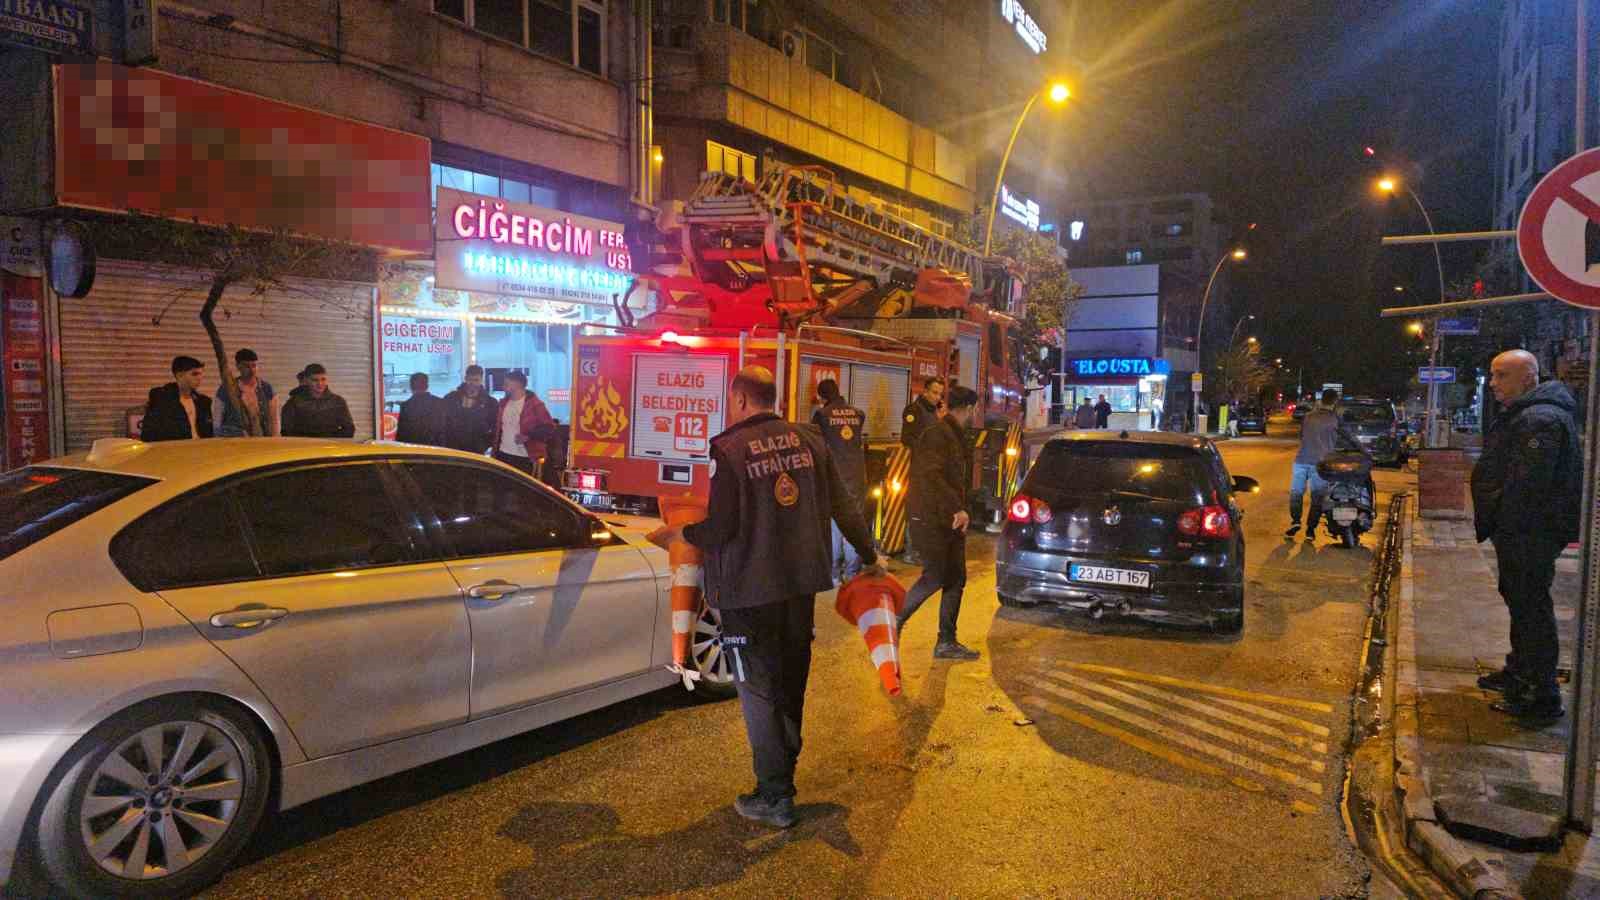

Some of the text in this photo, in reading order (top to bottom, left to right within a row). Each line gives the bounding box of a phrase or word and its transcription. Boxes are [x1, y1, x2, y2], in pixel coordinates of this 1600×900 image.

[454, 200, 593, 256] CİĞERCİM
[383, 341, 424, 352] FERHAT
[1110, 358, 1150, 374] USTA
[642, 393, 720, 413] BELEDİYESİ
[679, 416, 704, 436] 112
[745, 449, 815, 480] İTFAİYESİ
[1078, 567, 1149, 584] 23 ABT 167
